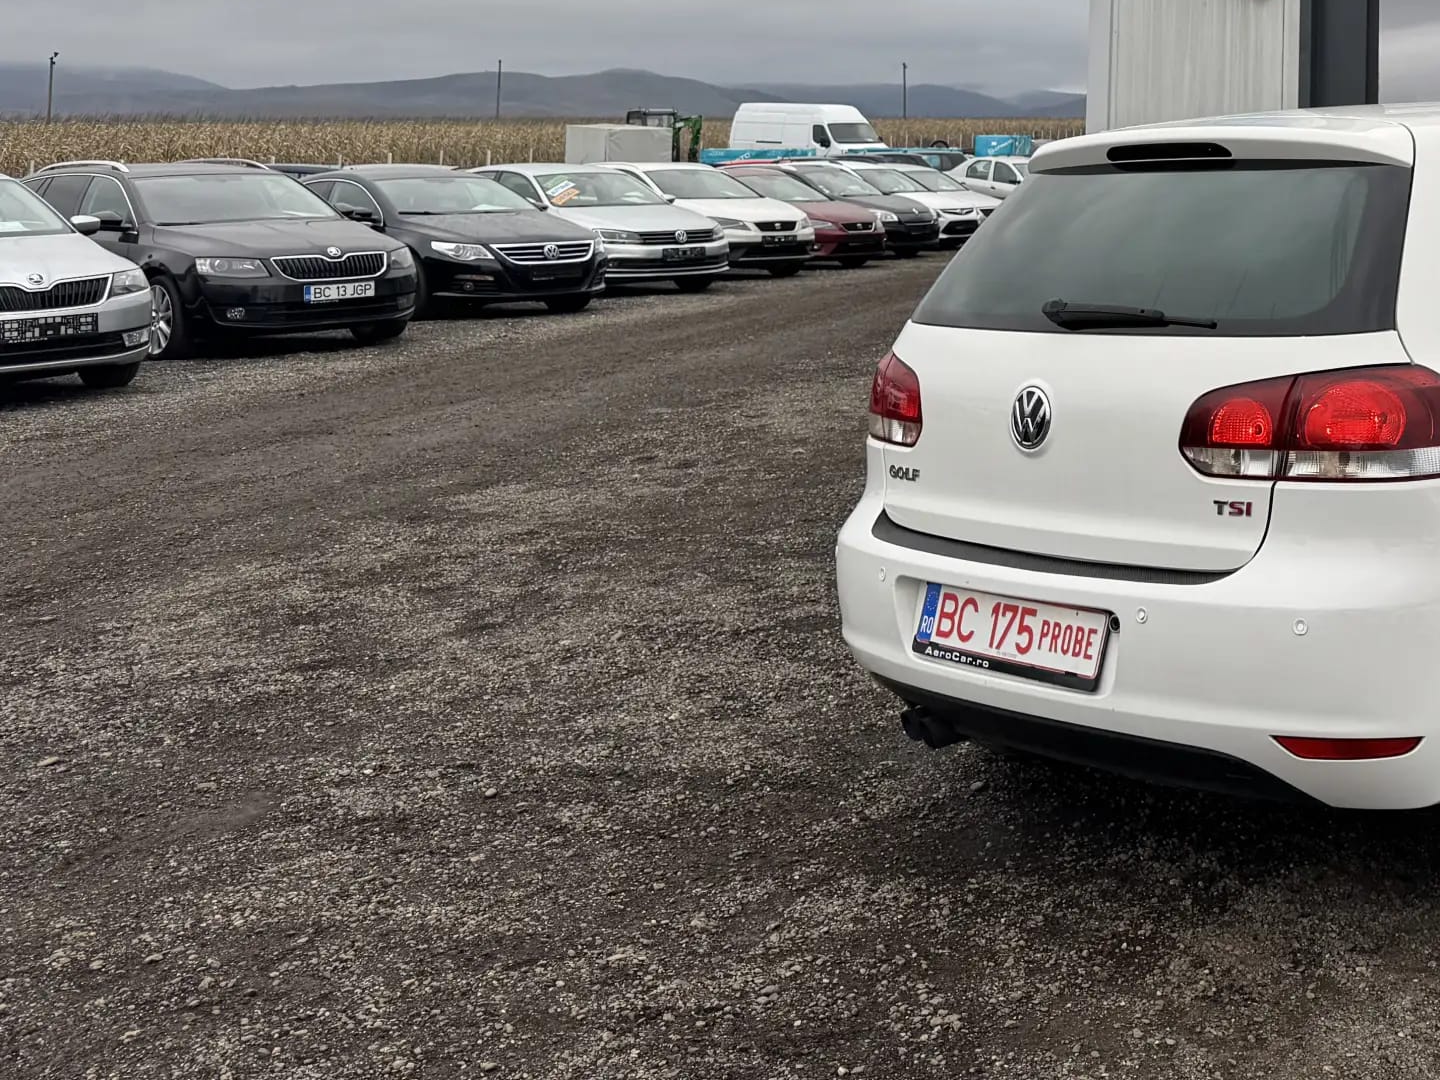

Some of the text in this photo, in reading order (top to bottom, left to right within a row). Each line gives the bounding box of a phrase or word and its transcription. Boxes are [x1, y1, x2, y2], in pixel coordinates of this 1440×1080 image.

[313, 278, 372, 299] BC 13 JGP
[1012, 386, 1051, 449] VW
[889, 464, 921, 482] GOLF
[1213, 500, 1252, 517] TSI
[920, 615, 933, 634] RO
[935, 592, 1098, 661] BC 175 PROBE
[925, 646, 990, 668] AeroCar.ro
